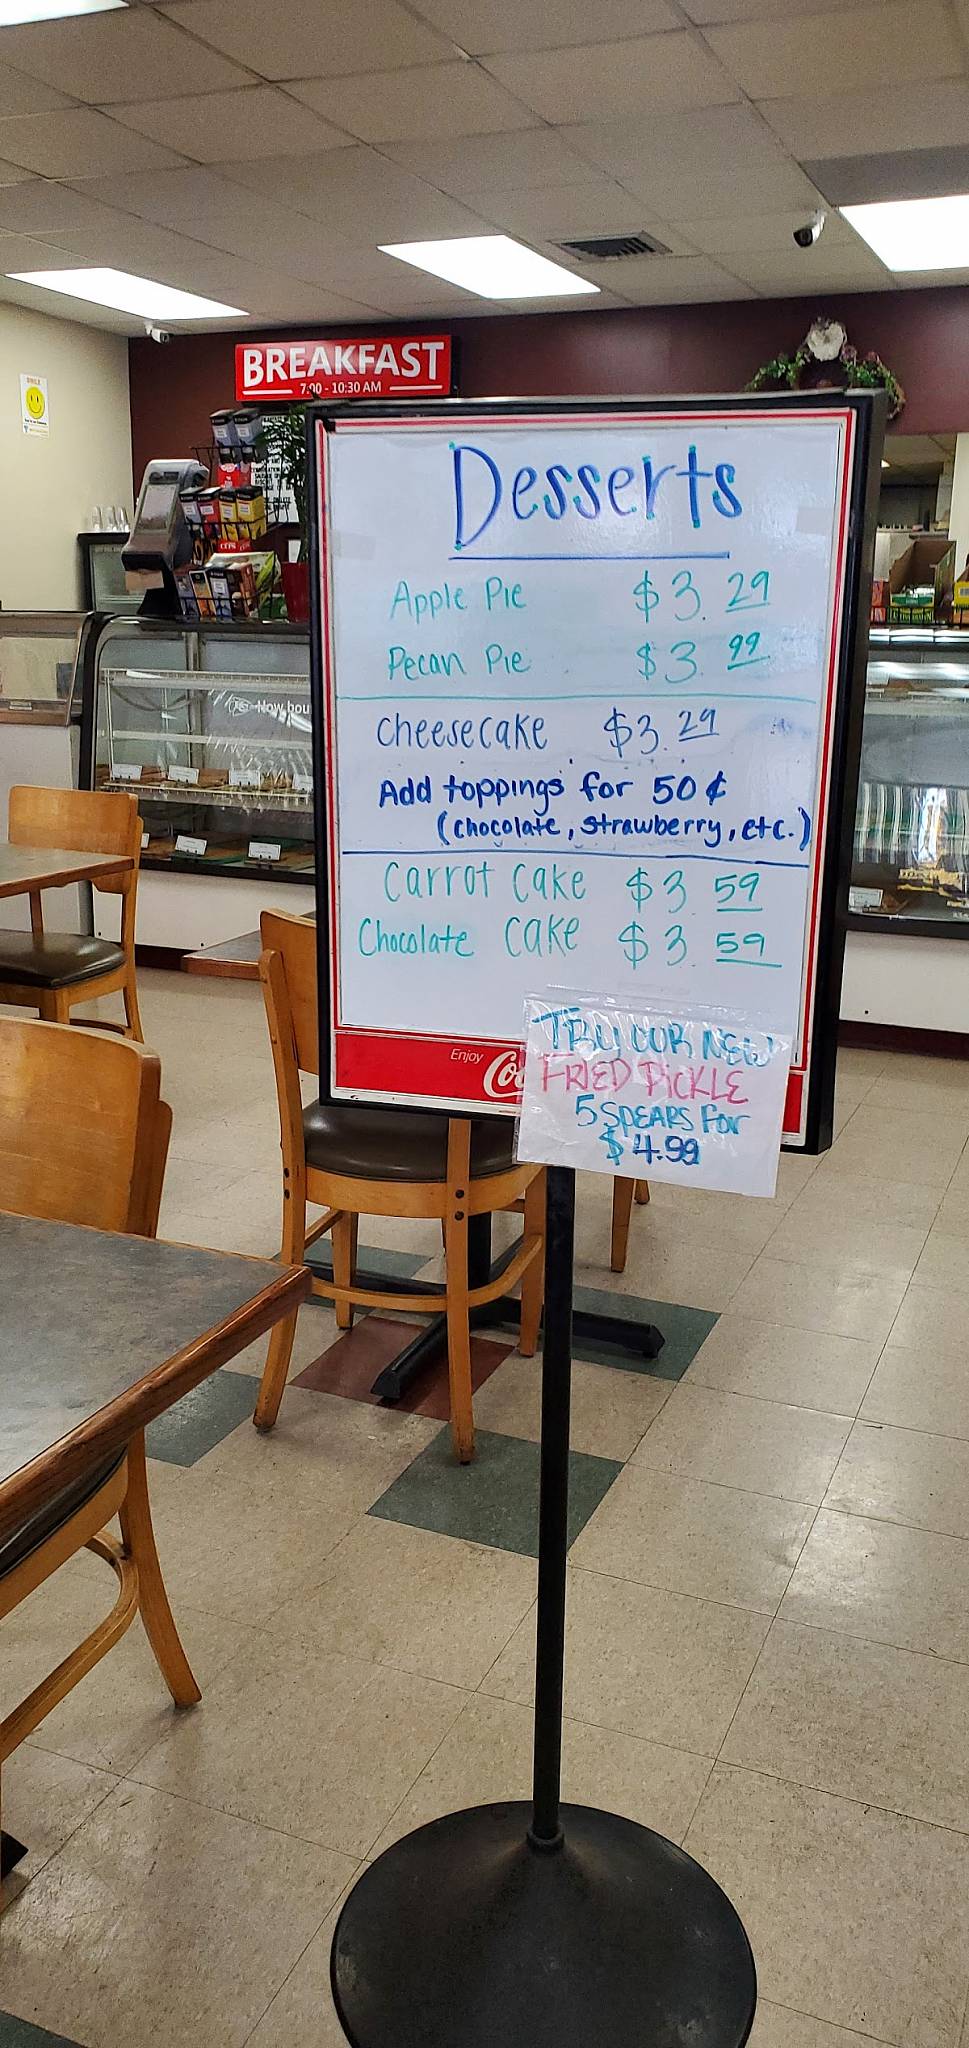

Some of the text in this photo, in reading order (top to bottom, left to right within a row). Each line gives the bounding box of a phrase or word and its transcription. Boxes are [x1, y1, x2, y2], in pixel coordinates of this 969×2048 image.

[243, 342, 445, 388] BREAKFAST
[300, 382, 322, 395] 7:00
[332, 381, 360, 394] 10:30
[362, 381, 382, 393] AM
[449, 441, 742, 551] Desserts
[389, 580, 468, 623] Apple
[485, 577, 527, 610] Pie
[388, 645, 465, 681] Pecan
[485, 643, 531, 677] Pie
[379, 777, 432, 808] Add
[442, 774, 563, 817] toppings
[579, 770, 633, 800] for
[384, 859, 496, 903] Carrot
[358, 917, 475, 957] Chocolate
[450, 1048, 484, 1064] Enjoy
[538, 1052, 632, 1093] FRIED
[575, 1092, 598, 1127] 5
